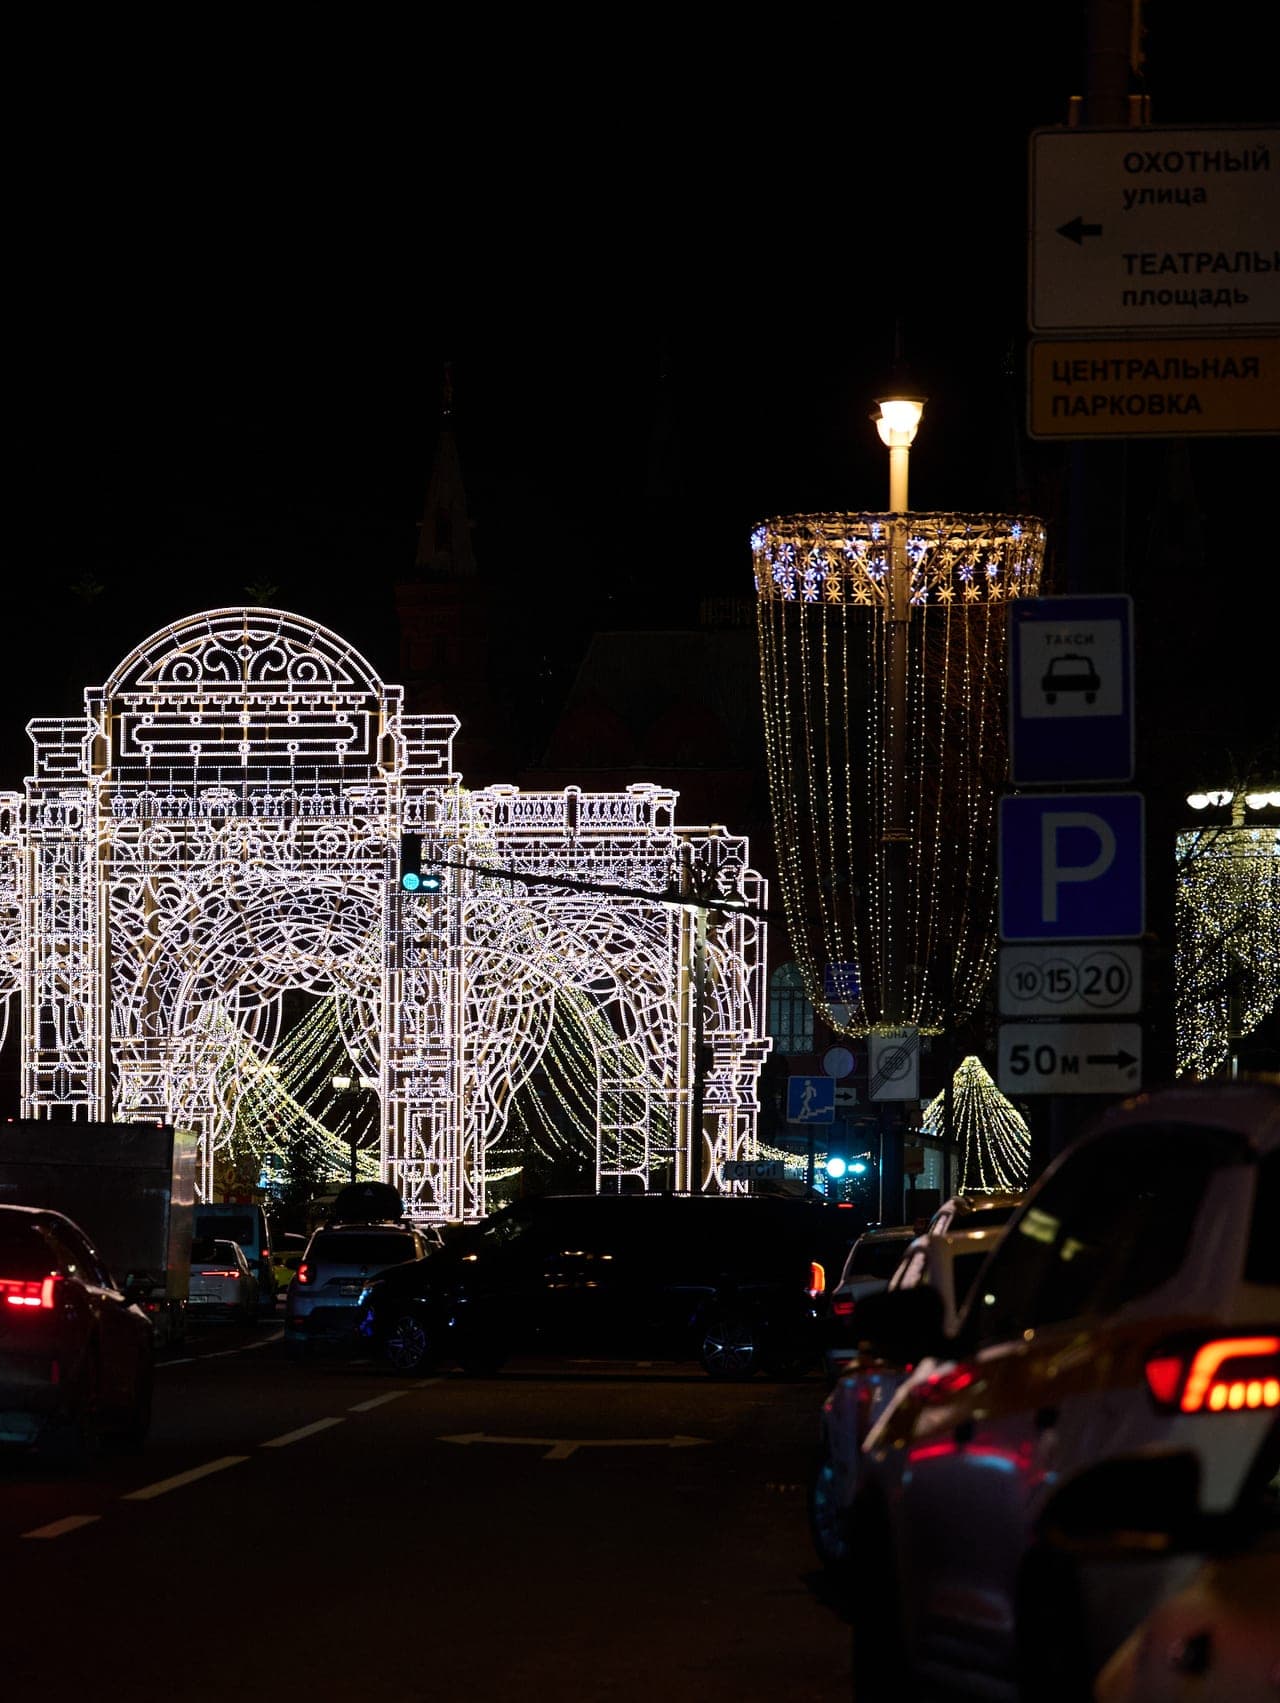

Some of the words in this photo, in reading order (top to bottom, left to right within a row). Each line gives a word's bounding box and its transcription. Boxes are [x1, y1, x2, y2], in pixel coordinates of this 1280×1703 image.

[1123, 145, 1269, 173] ОХОТНЫЙ
[1123, 187, 1207, 210] улица
[1123, 288, 1248, 308] площадь
[1051, 356, 1259, 384] ЦЕНТРАЛЬНАЯ
[1051, 393, 1202, 417] ПАРКОВКА
[1045, 632, 1096, 646] ТАКСИ
[1015, 971, 1037, 992] 10
[1047, 968, 1072, 993] 15
[1083, 965, 1125, 994] 20
